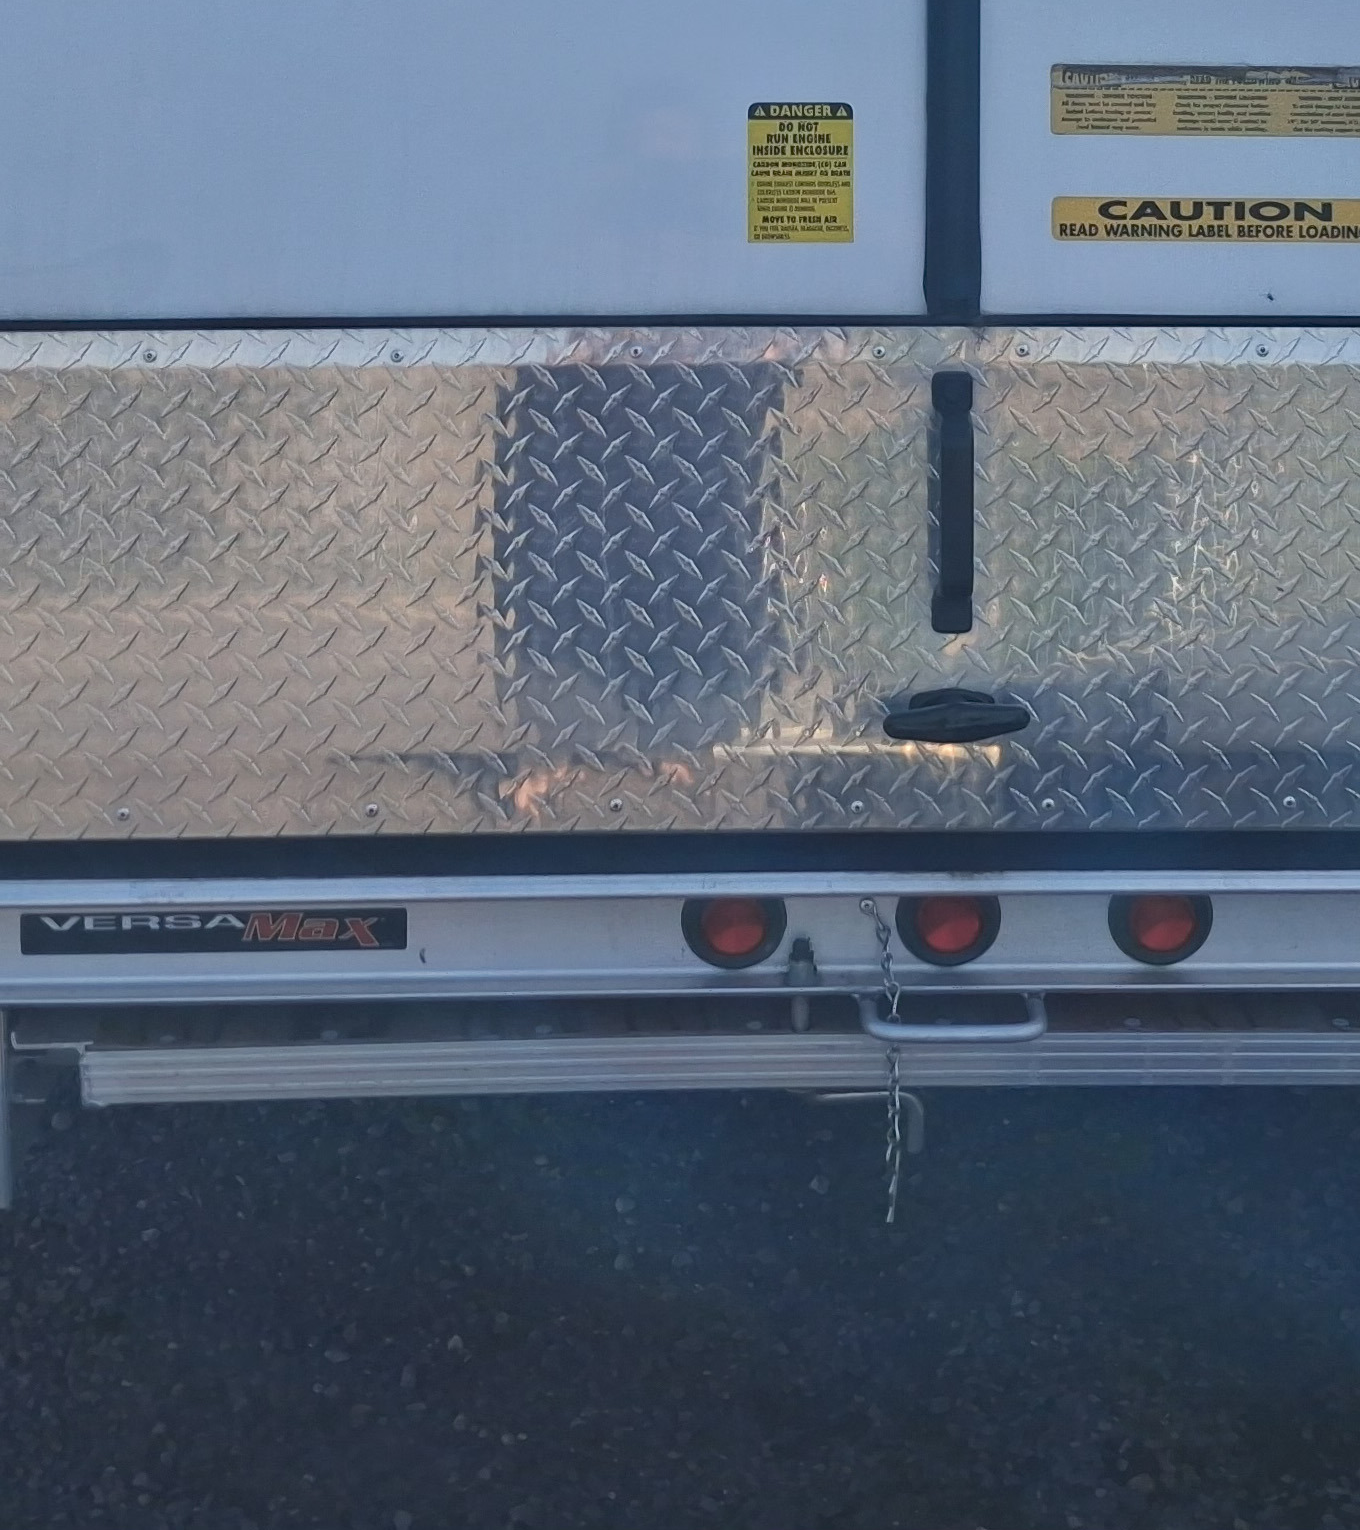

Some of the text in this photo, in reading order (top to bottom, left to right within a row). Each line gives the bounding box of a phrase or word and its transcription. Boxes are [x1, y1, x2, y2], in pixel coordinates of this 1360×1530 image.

[769, 104, 832, 117] DANGER
[778, 121, 819, 132] DO NOT
[766, 133, 832, 144] RUN ENGINE
[752, 145, 849, 156] INSIDE ENCLOSURE
[1097, 200, 1334, 223] CAUTION
[762, 216, 784, 224] MOVE
[786, 216, 796, 224] TO
[824, 216, 838, 224] AIR
[1059, 223, 1099, 237] READ
[1104, 223, 1183, 238] WARNING
[1188, 224, 1232, 238] LABEL
[1237, 224, 1294, 239] BEFORE
